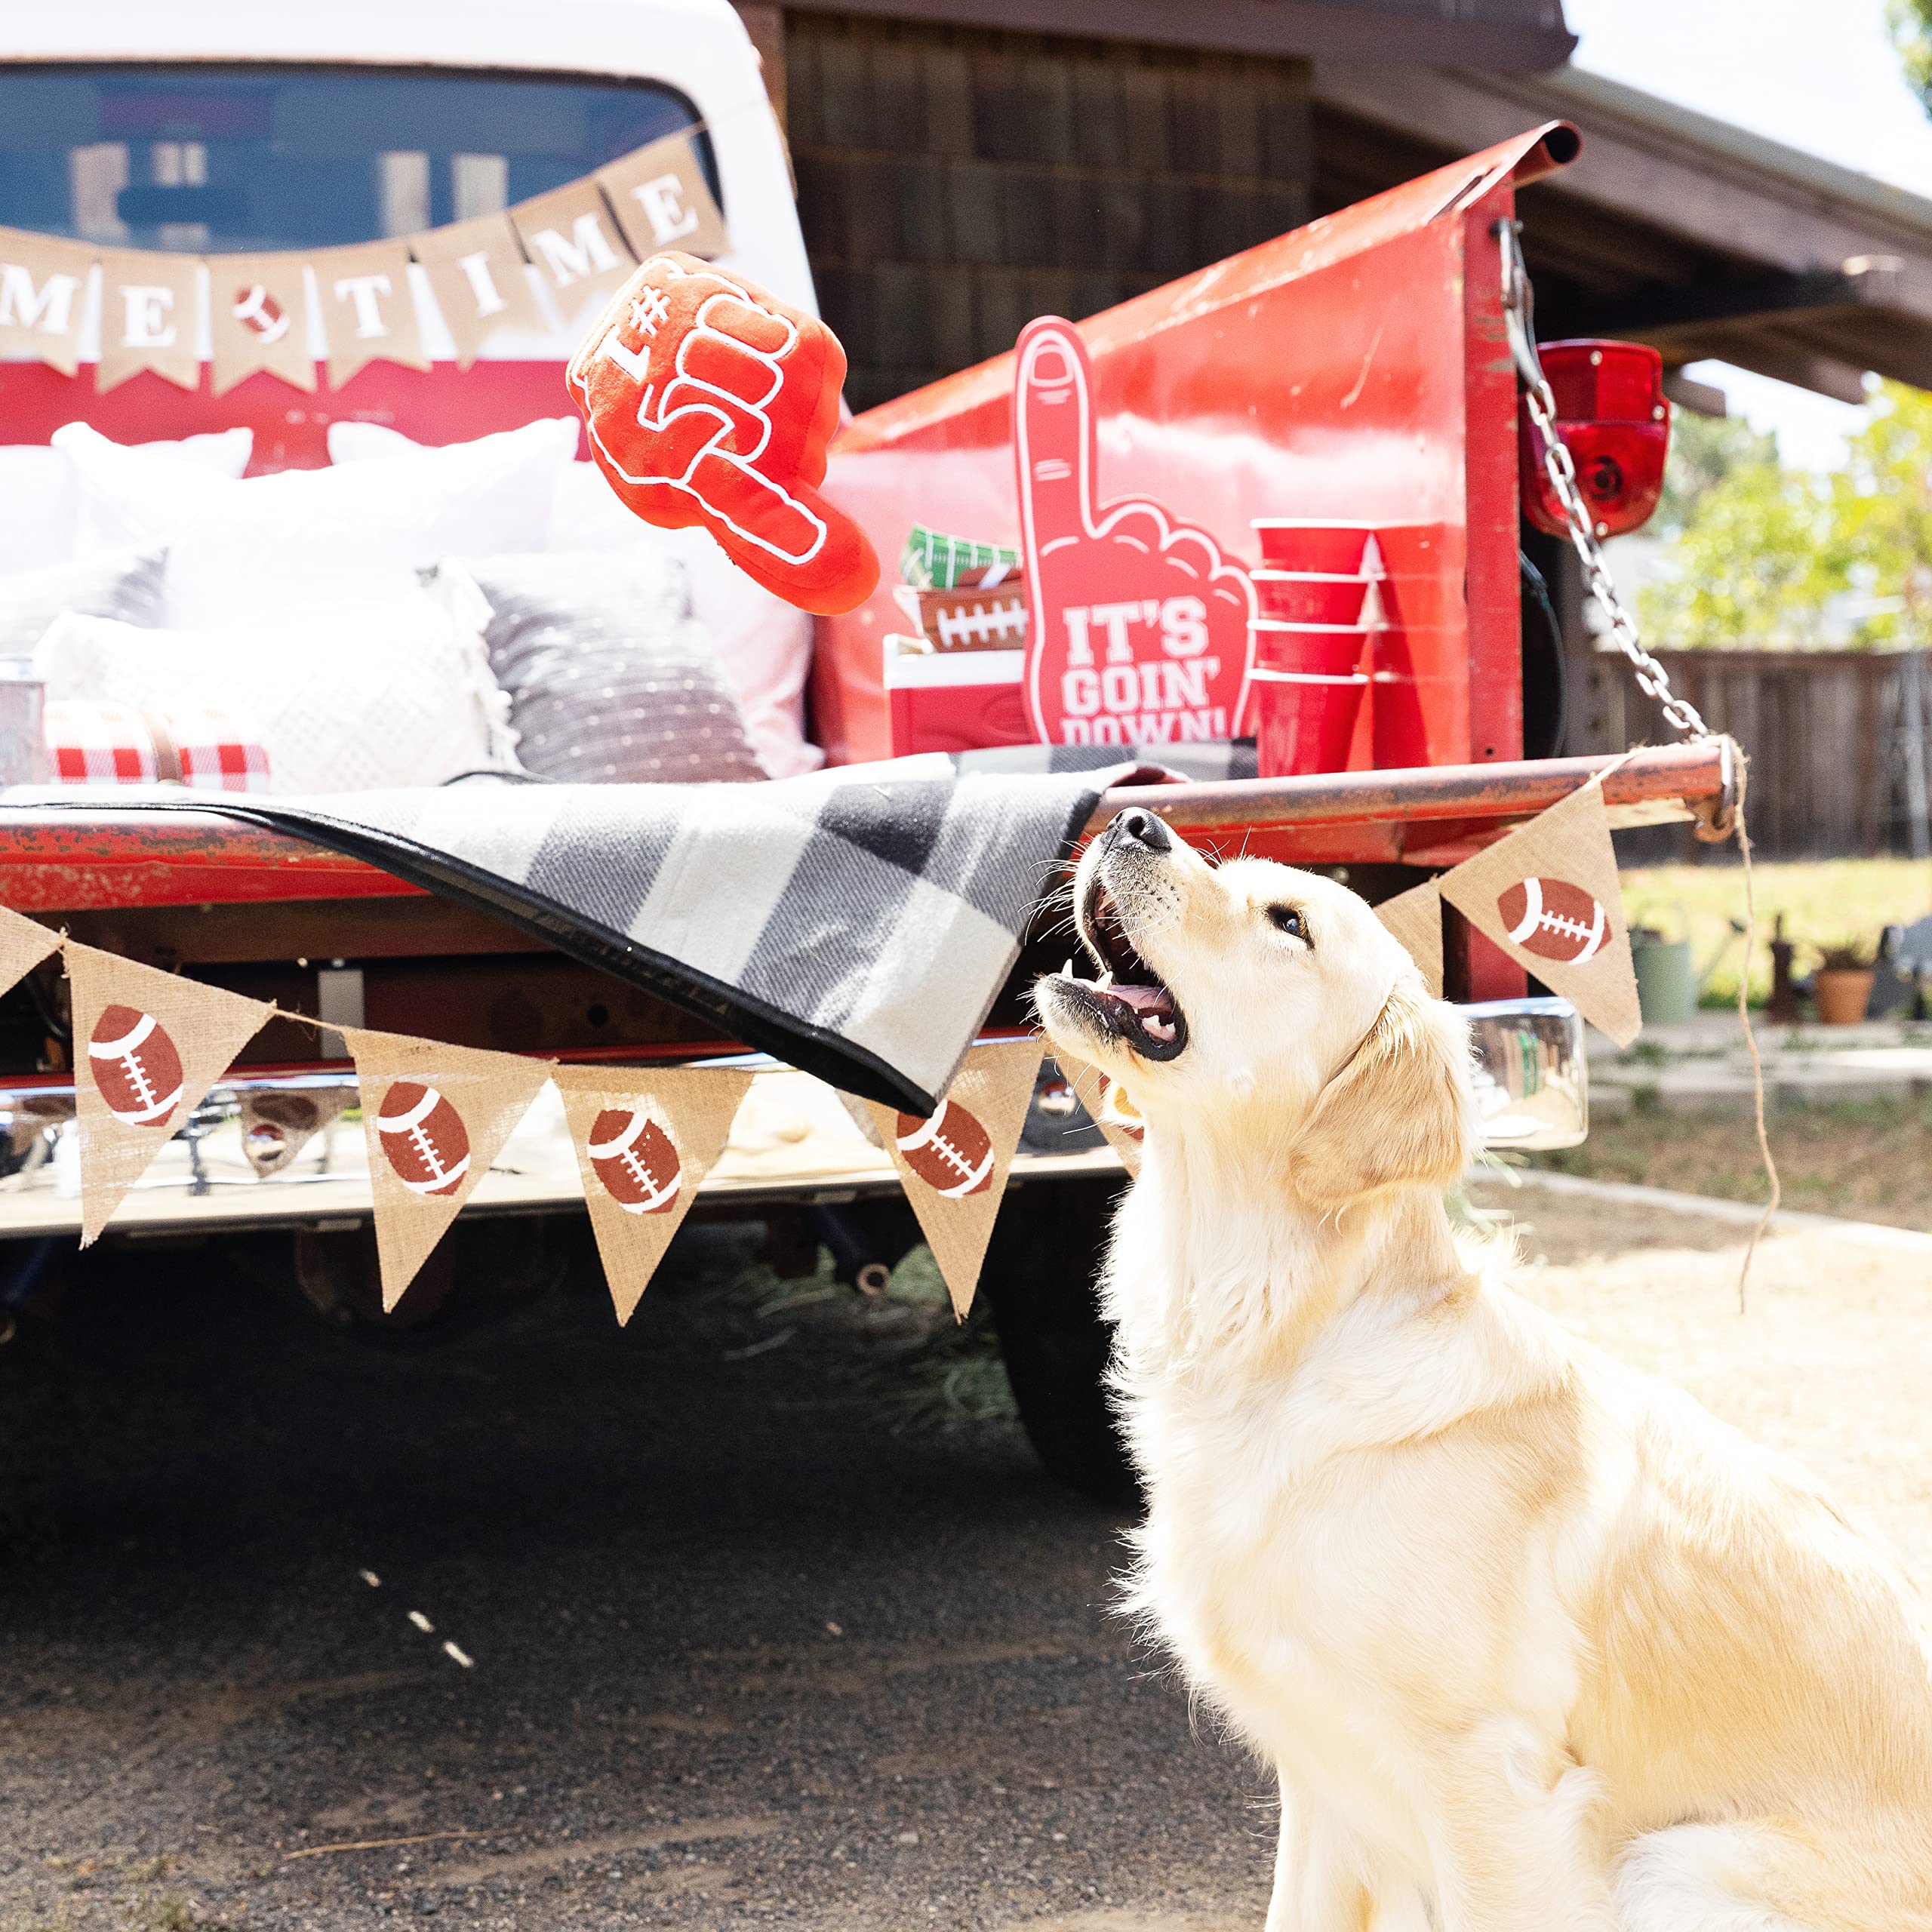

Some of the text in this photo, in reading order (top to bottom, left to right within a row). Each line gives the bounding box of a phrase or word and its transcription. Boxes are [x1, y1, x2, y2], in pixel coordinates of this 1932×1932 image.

[334, 173, 700, 339] TIME
[593, 285, 670, 384] #1
[1063, 595, 1209, 666] IT'S
[1060, 656, 1220, 716] GOIN'
